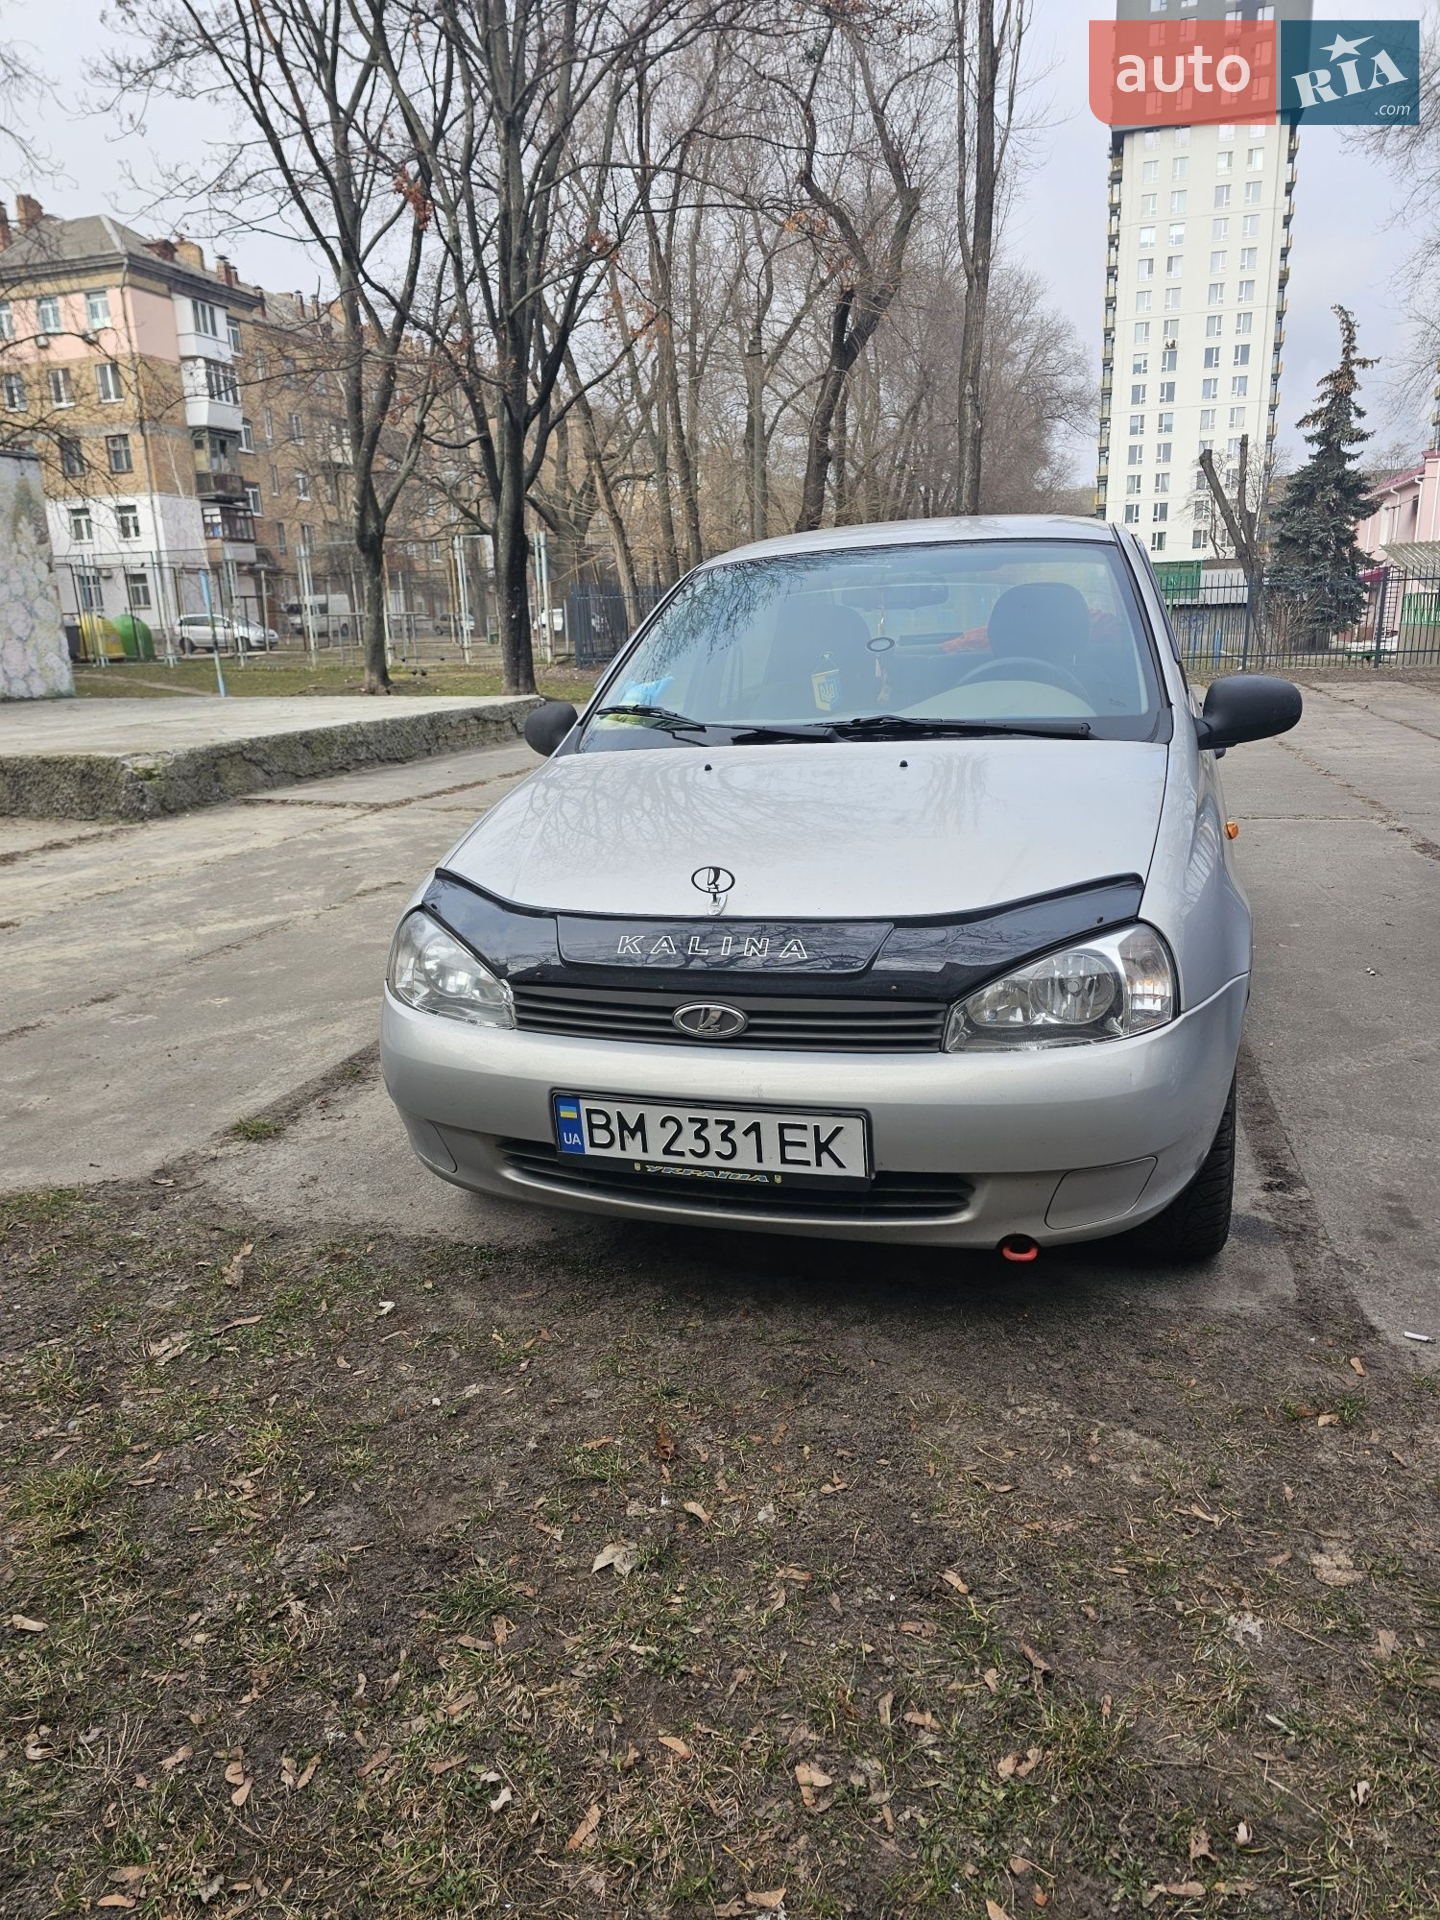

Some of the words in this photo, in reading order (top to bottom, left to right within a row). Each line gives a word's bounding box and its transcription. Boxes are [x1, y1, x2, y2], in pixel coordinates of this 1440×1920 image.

[617, 935, 808, 959] KALINA
[563, 1132, 582, 1146] UA
[585, 1107, 648, 1154] BM
[659, 1115, 764, 1163] 2331
[777, 1122, 847, 1169] EK
